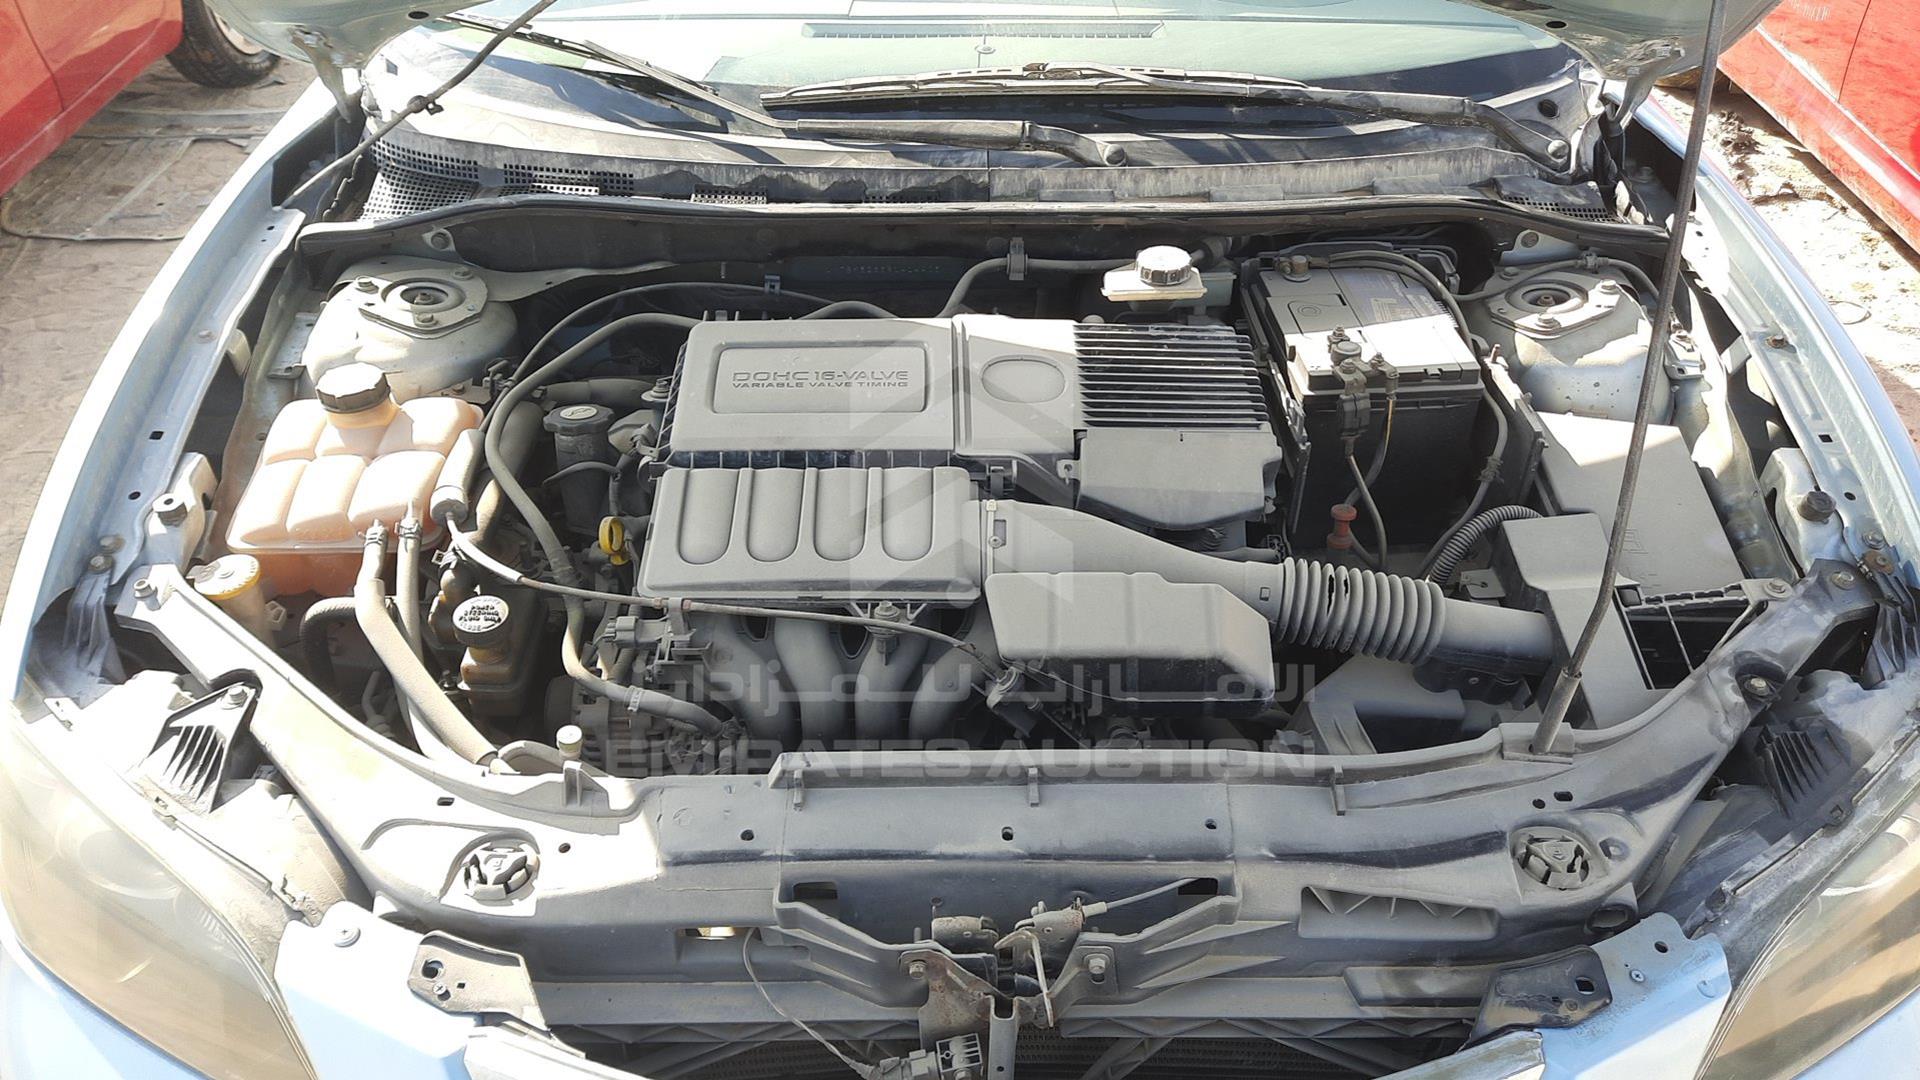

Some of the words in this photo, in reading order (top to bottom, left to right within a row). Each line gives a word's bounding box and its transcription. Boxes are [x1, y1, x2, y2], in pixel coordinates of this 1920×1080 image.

[733, 371, 810, 382] DOHC
[814, 371, 909, 382] 16-VALVE
[732, 381, 805, 389] VARIABLE
